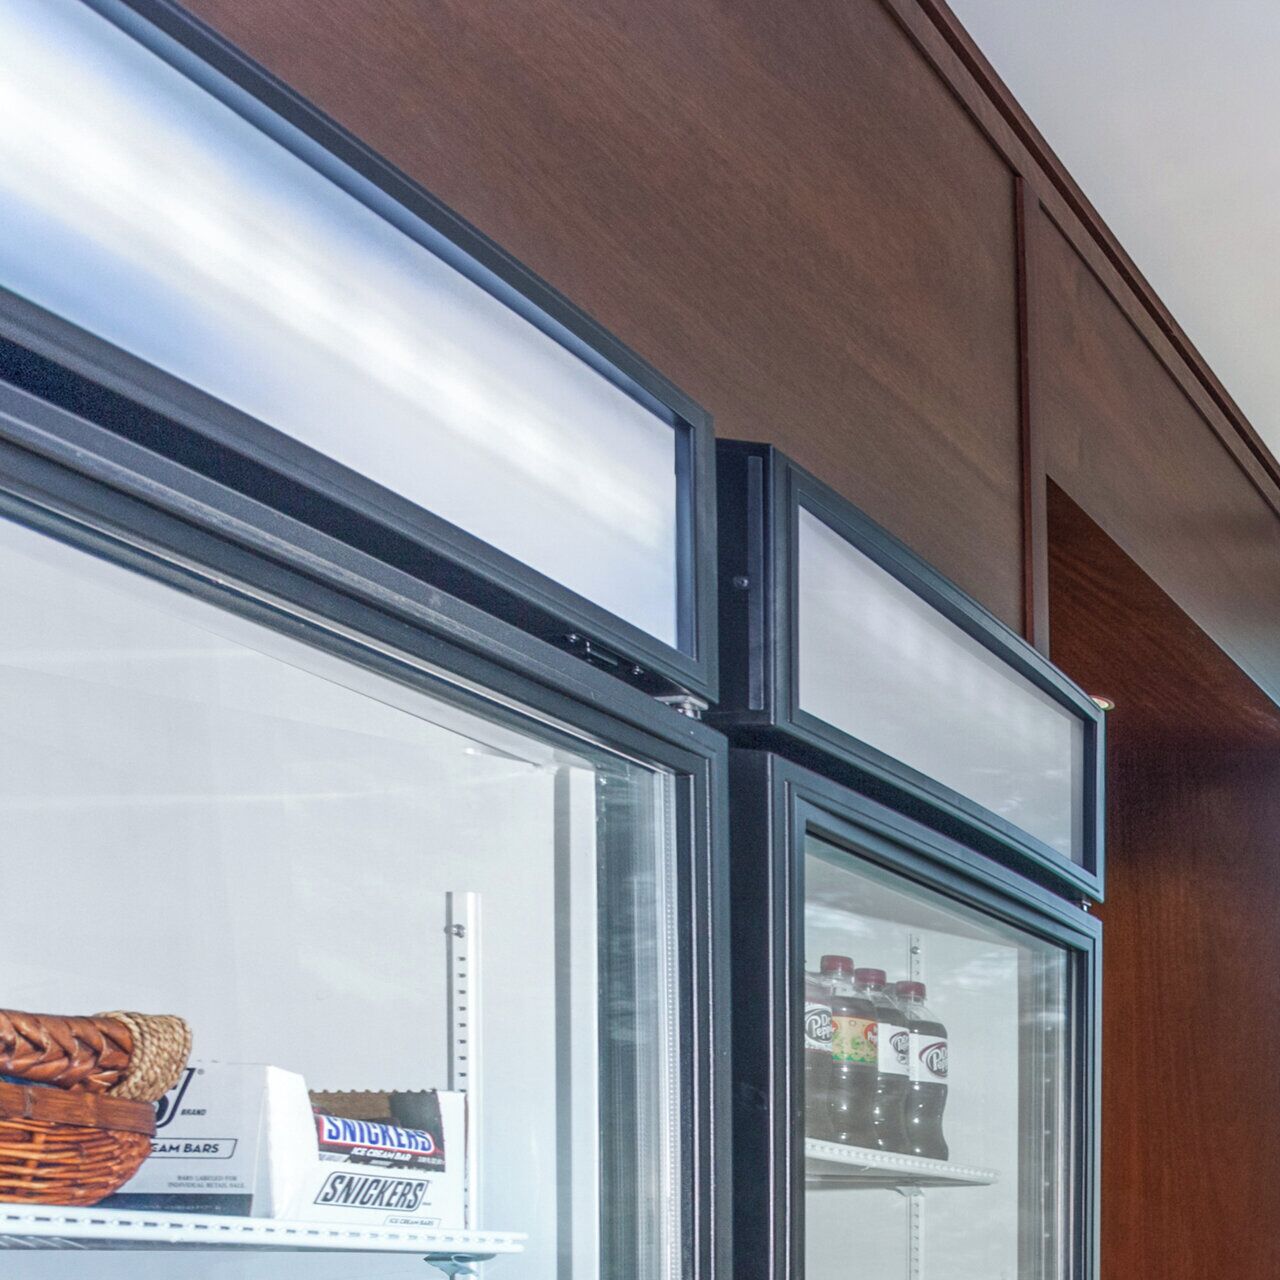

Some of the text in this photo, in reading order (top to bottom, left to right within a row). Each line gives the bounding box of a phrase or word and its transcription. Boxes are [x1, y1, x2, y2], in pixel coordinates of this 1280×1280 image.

[325, 1115, 433, 1152] SNICKERS
[183, 1143, 219, 1153] BARS
[351, 1147, 367, 1156] ICE
[367, 1149, 396, 1159] CREAM
[395, 1152, 412, 1161] BAR
[321, 1174, 425, 1210] SNICKERS
